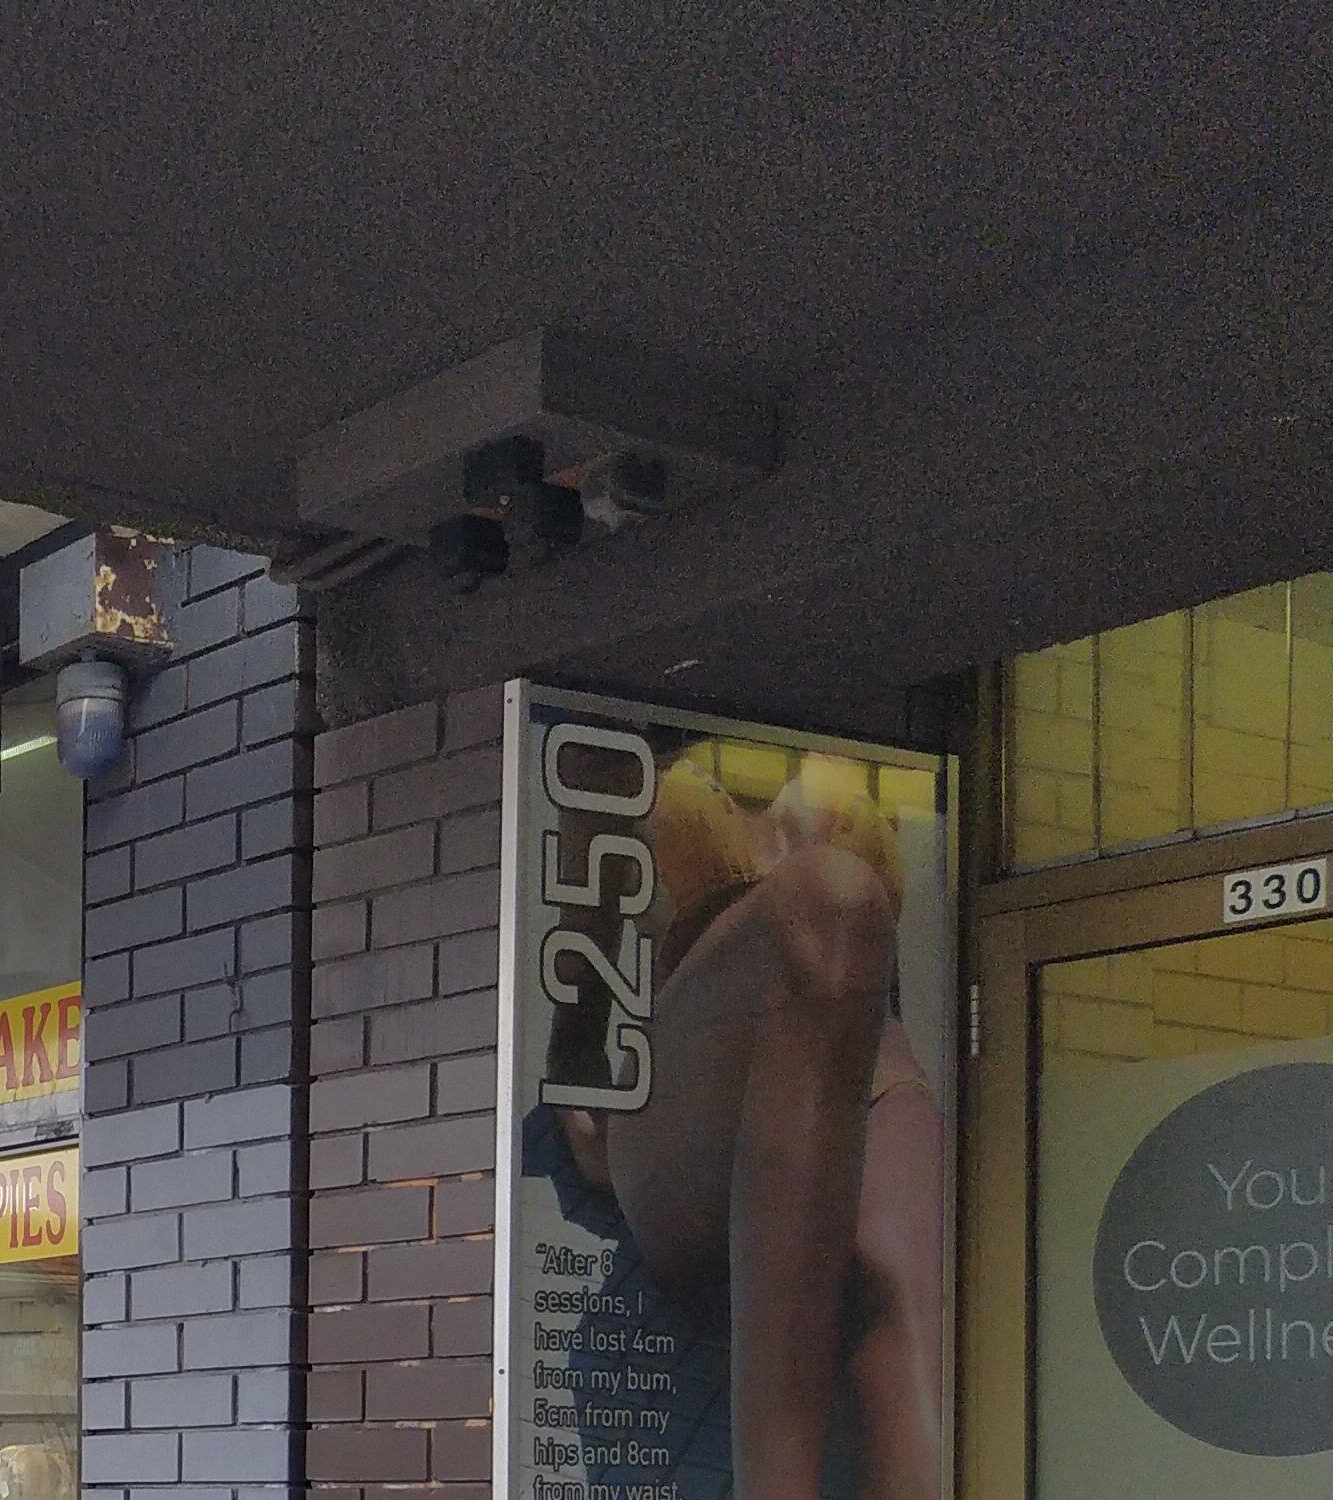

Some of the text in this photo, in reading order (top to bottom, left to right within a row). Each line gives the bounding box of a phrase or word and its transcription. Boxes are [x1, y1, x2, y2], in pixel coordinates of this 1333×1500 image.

[1229, 868, 1321, 915] 330
[538, 723, 656, 1111] L250
[1207, 1159, 1326, 1211] You
[600, 1249, 614, 1276] 8
[1124, 1224, 1333, 1292] Compl
[535, 1288, 643, 1317] sessions, I
[535, 1325, 674, 1353] have lost 4cm
[535, 1364, 677, 1395] from my bum,
[535, 1402, 669, 1434] 5cm from my
[535, 1439, 669, 1470] hips and 8cm
